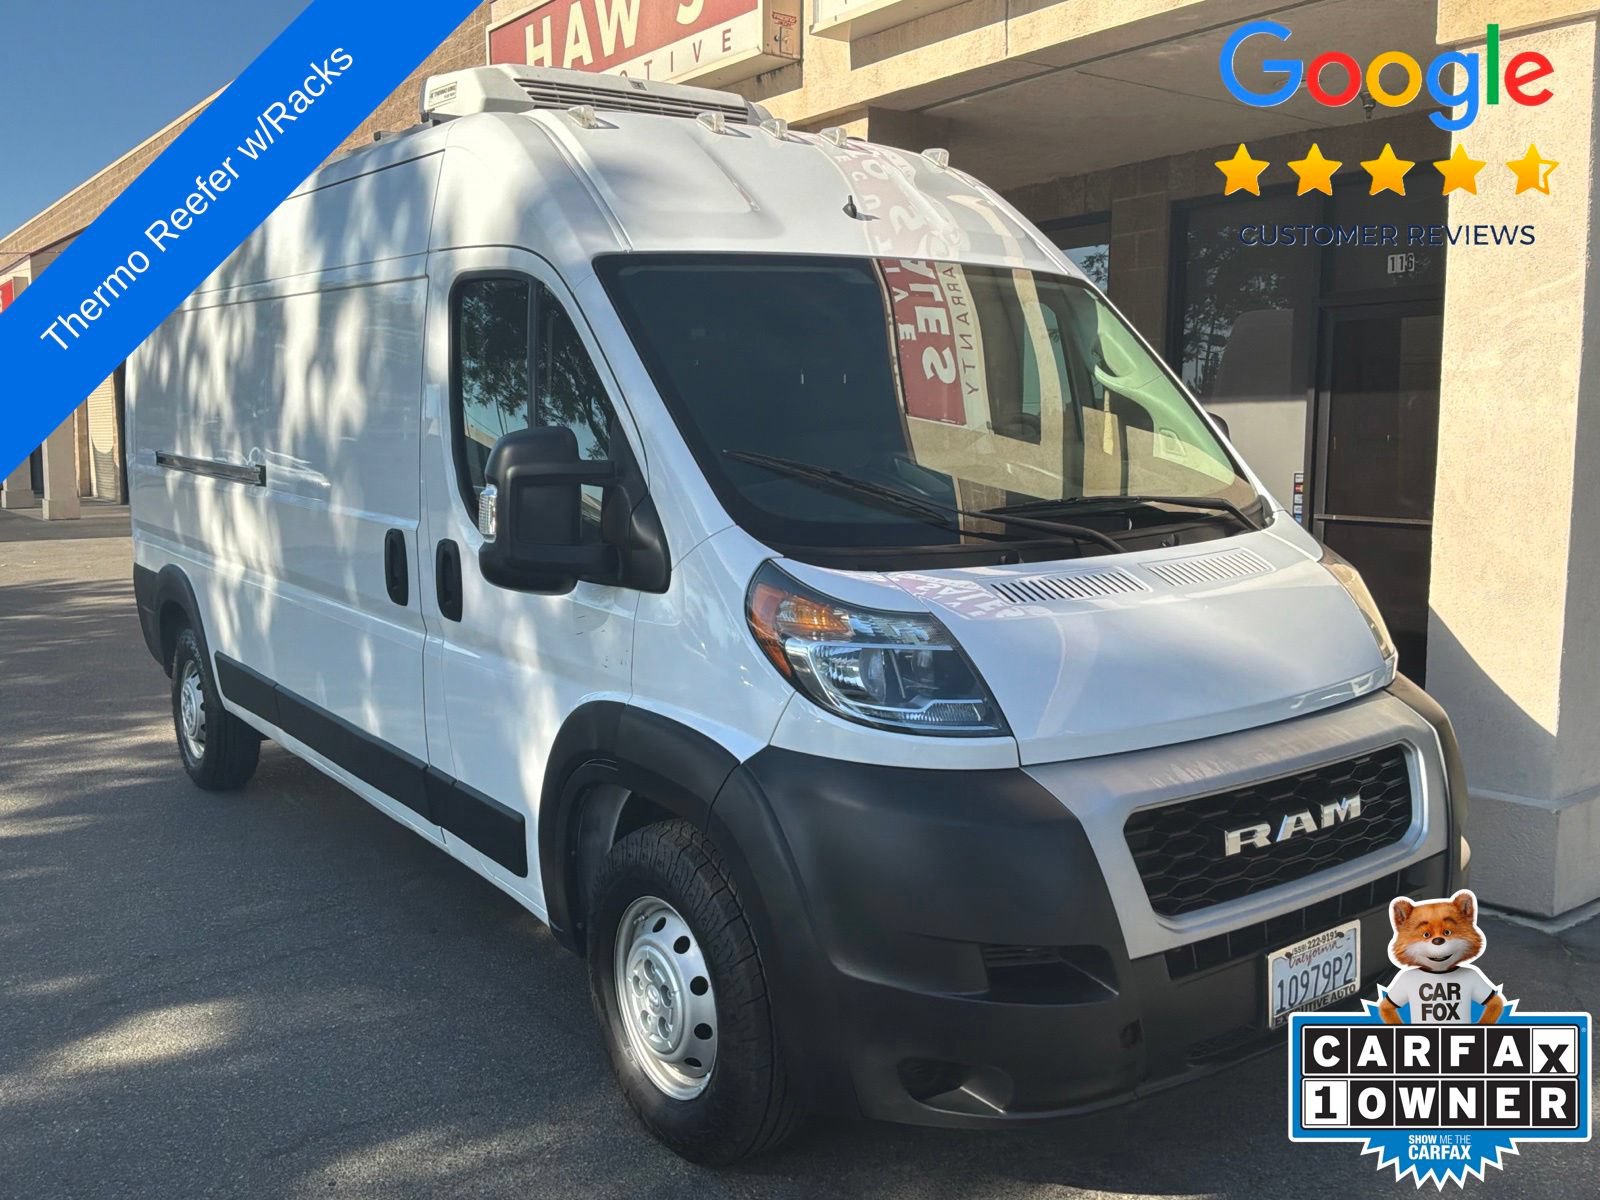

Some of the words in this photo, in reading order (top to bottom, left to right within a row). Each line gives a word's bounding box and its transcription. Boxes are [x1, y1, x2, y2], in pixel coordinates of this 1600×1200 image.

[1390, 254, 1414, 272] 116
[1225, 794, 1361, 857] RAM
[1277, 951, 1354, 1015] 10979P2
[1330, 983, 1356, 1001] AUTO
